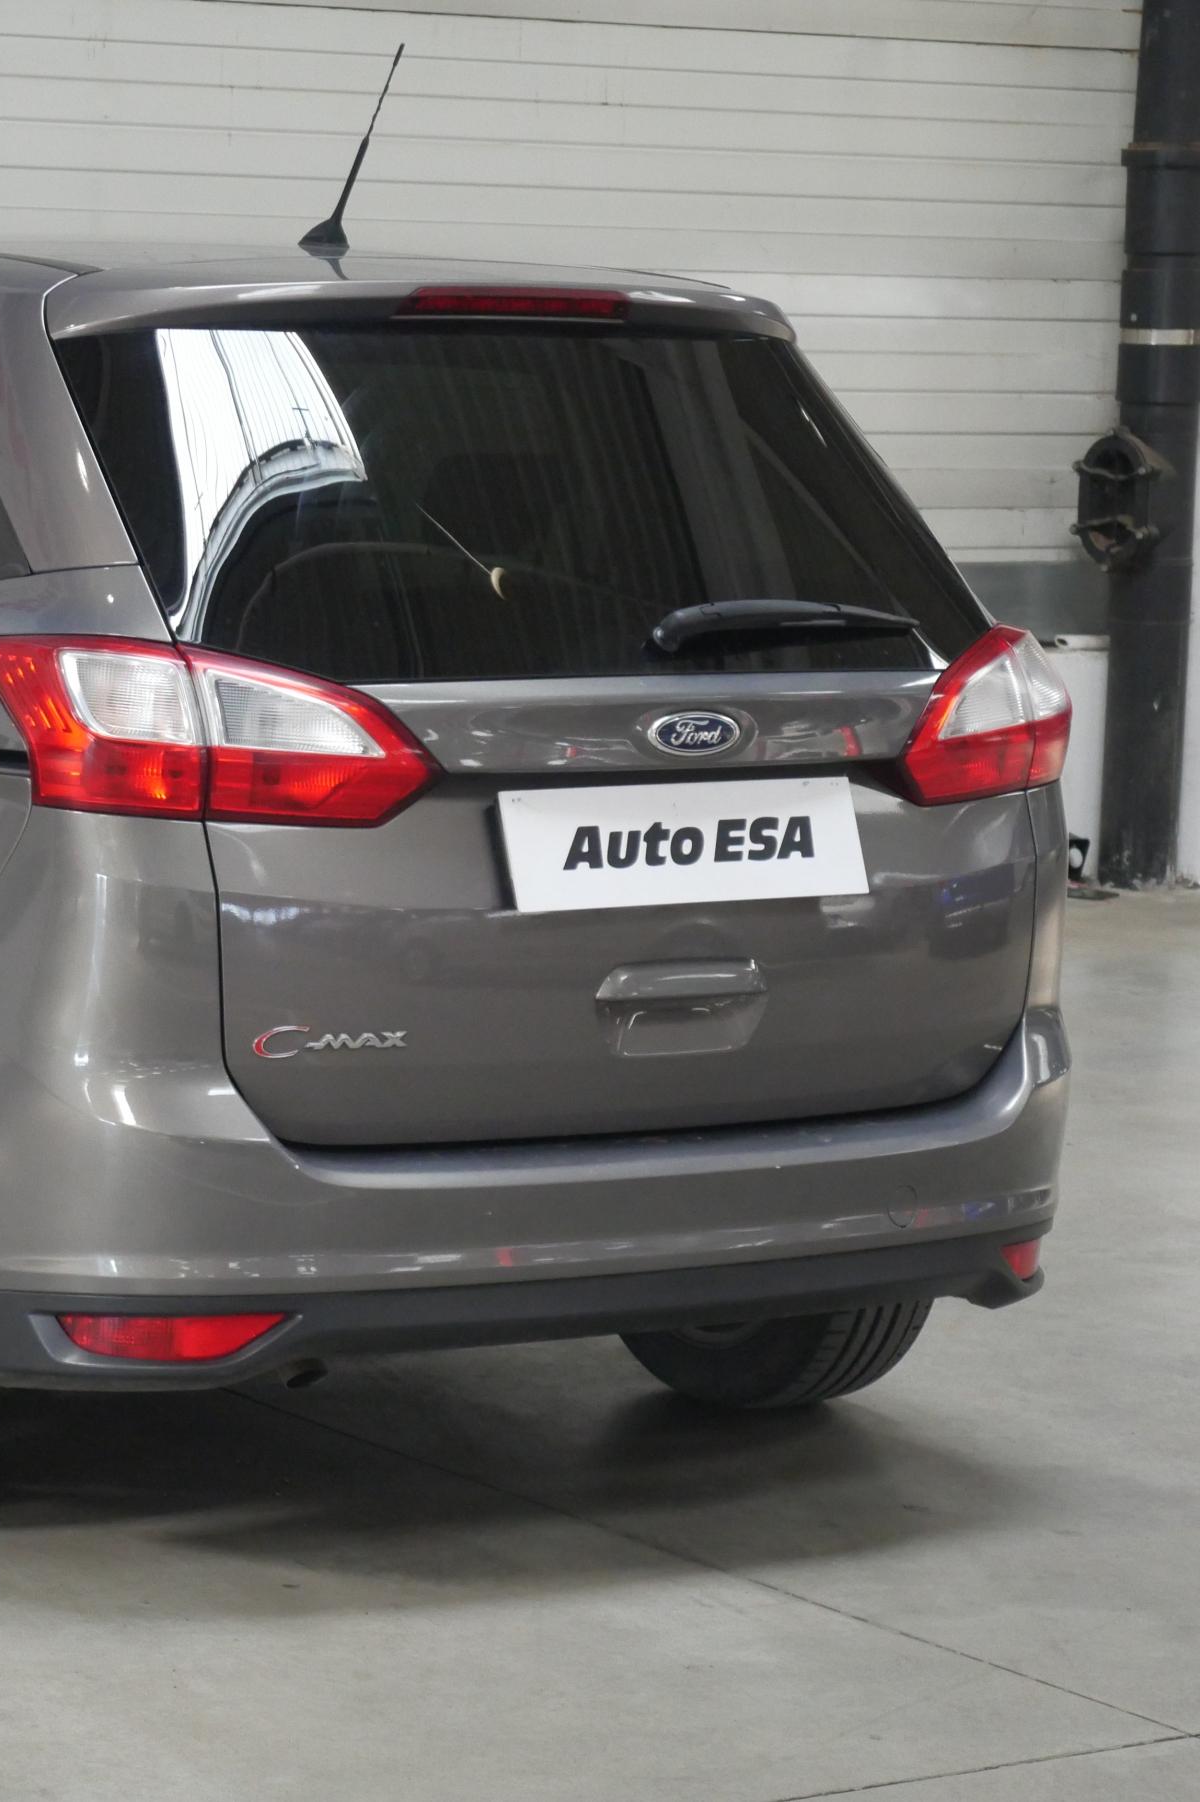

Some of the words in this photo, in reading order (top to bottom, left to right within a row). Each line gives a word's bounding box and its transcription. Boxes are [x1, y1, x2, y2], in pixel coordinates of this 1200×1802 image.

[671, 719, 722, 746] Ford
[563, 822, 704, 871] Auto
[713, 816, 815, 864] ESA
